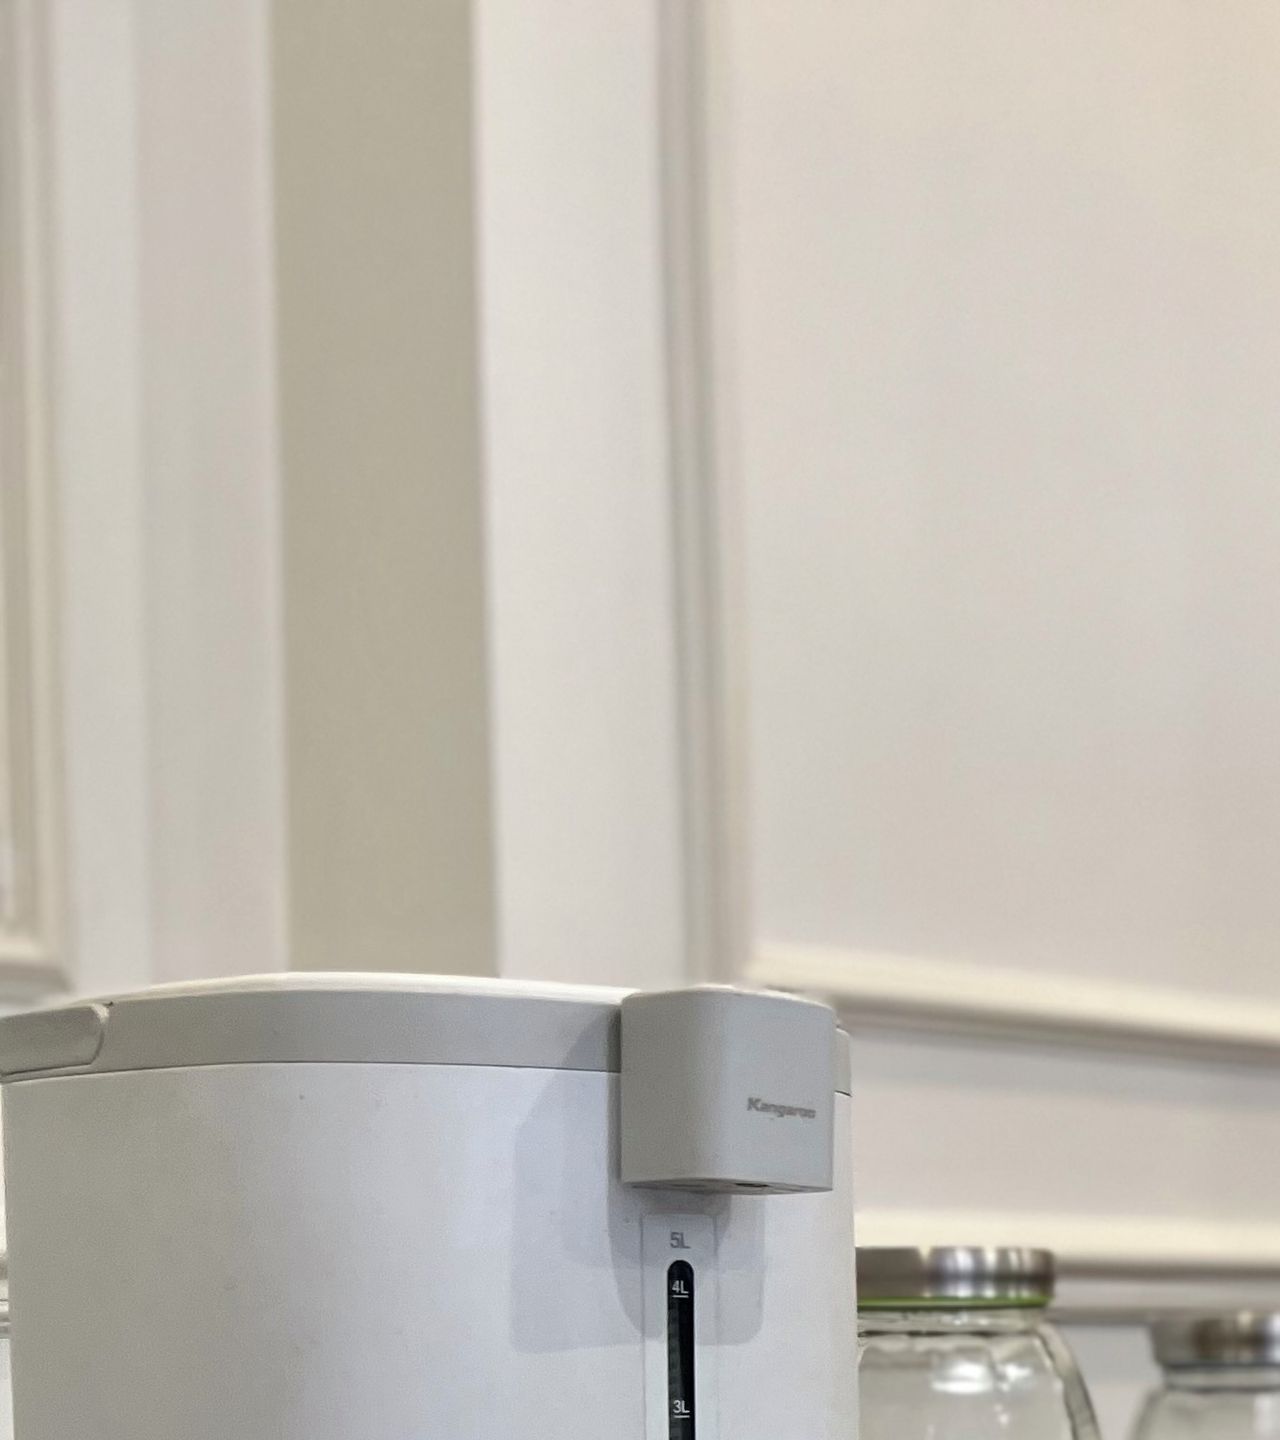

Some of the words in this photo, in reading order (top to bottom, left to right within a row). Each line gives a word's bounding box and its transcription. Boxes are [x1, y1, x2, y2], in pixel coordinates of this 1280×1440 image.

[746, 1097, 816, 1119] Kangaroo
[670, 1231, 691, 1249] 5L
[671, 1279, 689, 1294] 4L
[673, 1399, 691, 1414] 3L
